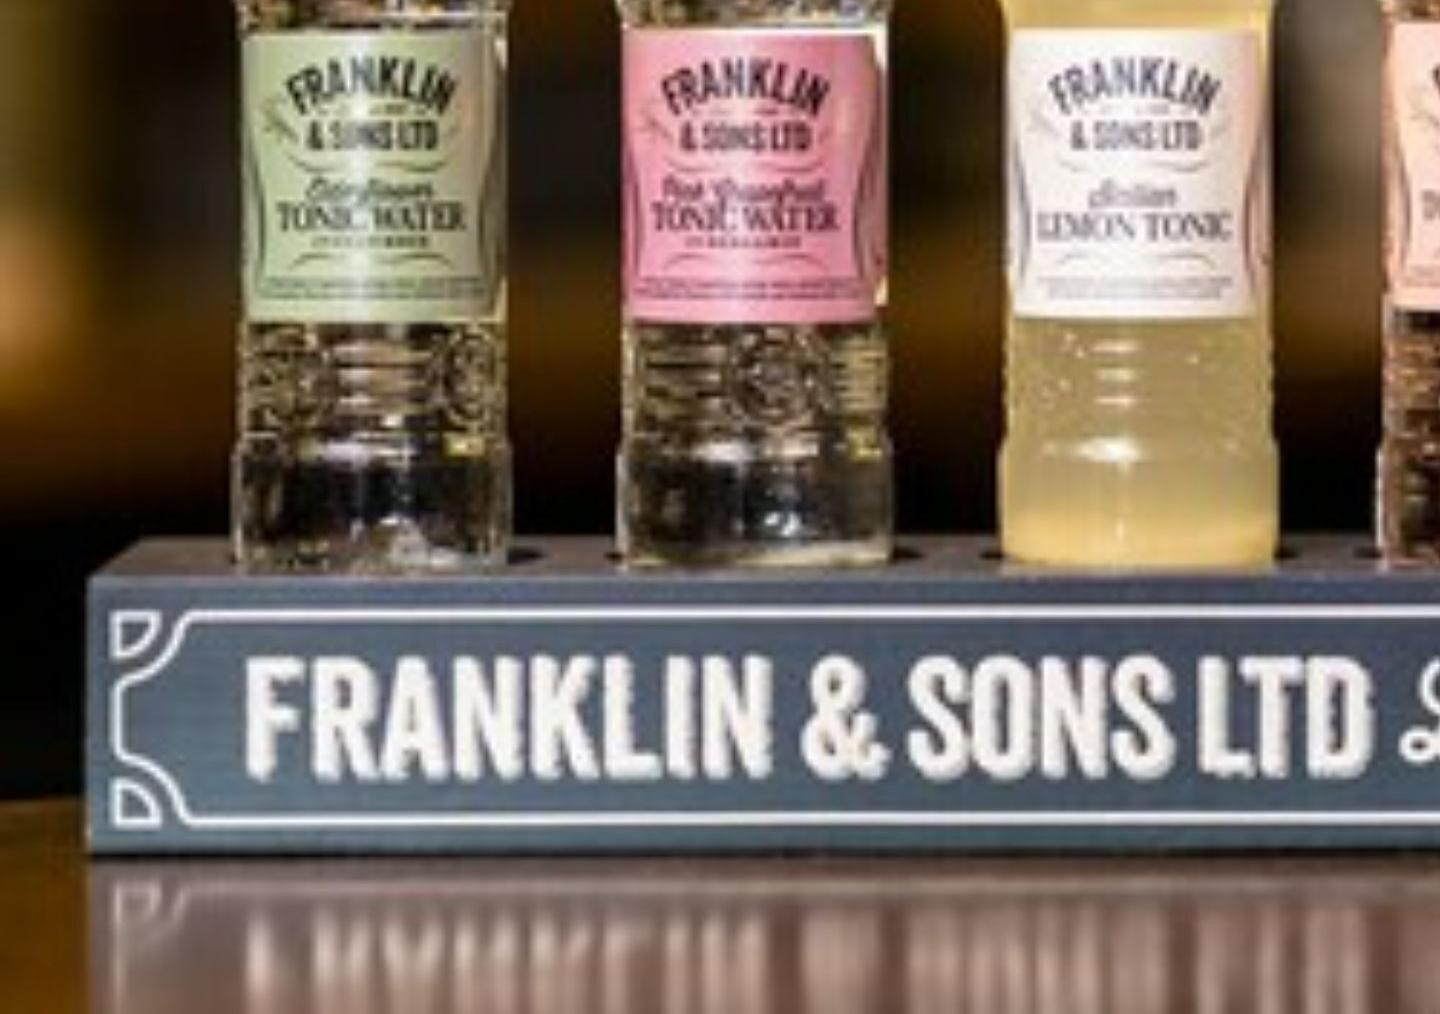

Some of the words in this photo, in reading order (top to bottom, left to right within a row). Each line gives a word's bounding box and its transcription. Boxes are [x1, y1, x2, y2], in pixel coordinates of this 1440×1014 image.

[285, 56, 457, 116] FRANKLIN
[661, 56, 830, 117] FRANKLIN
[1048, 55, 1221, 116] FRANKLIN
[306, 120, 323, 150] &
[330, 120, 392, 150] SONS
[397, 120, 438, 150] LTD
[679, 120, 697, 151] &
[702, 120, 764, 151] SONS
[770, 120, 812, 151] LTD
[1071, 120, 1087, 150] &
[1093, 120, 1155, 150] SONS
[1162, 120, 1201, 150] LTD
[276, 201, 367, 231] TONIC
[371, 201, 467, 231] WATER
[652, 201, 738, 232] TONIC
[743, 201, 840, 232] WATER
[1037, 211, 1137, 242] LEMON
[1142, 211, 1233, 242] TONIC
[245, 655, 774, 782] FRANKLIN
[799, 655, 892, 782] &
[905, 655, 1177, 782] SONS
[1198, 655, 1377, 780] LTD
